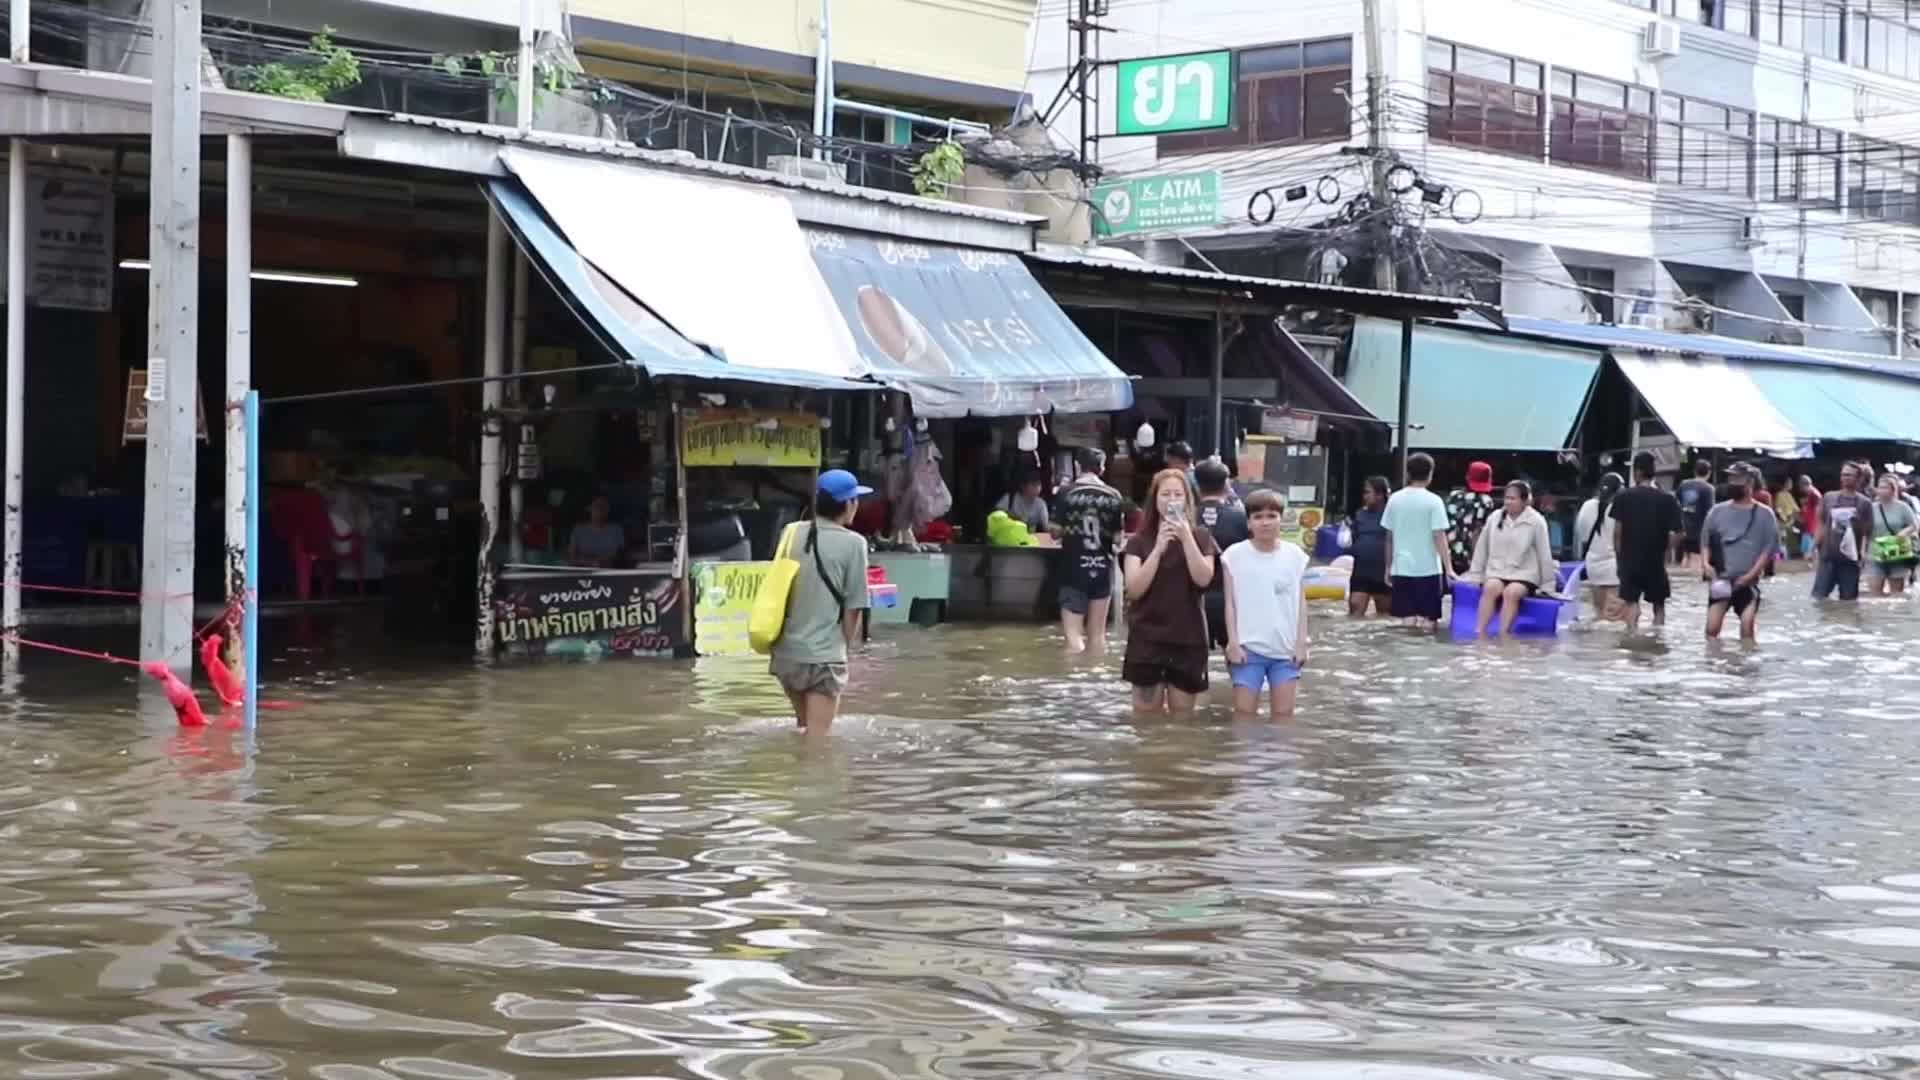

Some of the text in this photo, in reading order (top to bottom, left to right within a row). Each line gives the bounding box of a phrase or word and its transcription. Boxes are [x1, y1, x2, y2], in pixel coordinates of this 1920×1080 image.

[1133, 61, 1214, 126] ยา
[1160, 177, 1201, 200] ATM
[1082, 515, 1101, 551] 9
[499, 587, 657, 642] น้ำพริกตามสั่ง
